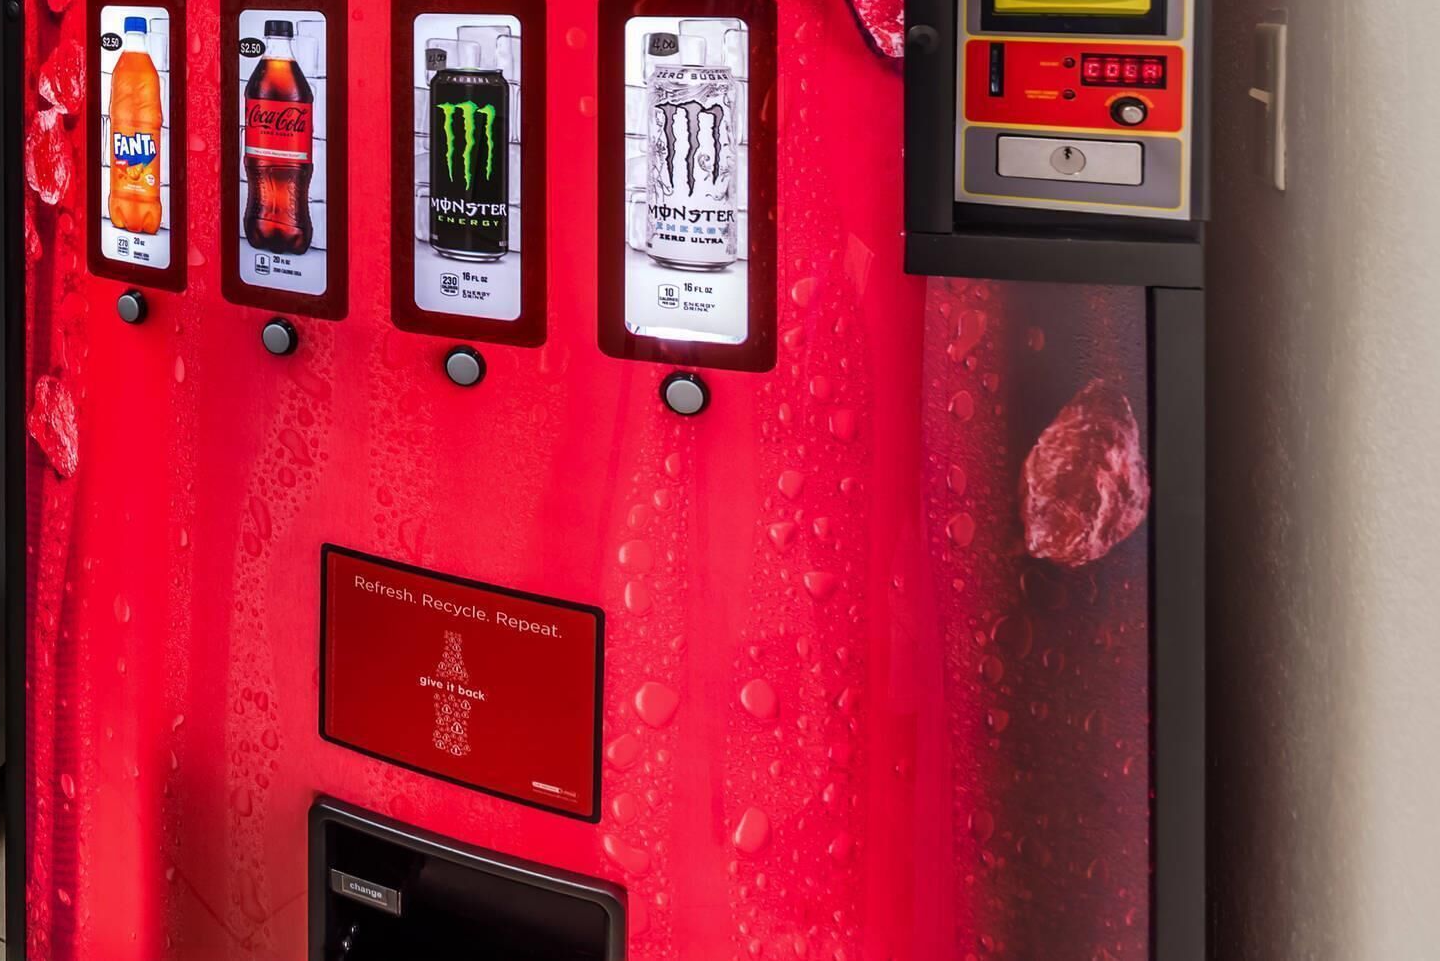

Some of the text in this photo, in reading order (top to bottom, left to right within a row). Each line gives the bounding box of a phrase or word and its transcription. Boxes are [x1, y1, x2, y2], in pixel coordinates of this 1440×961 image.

[103, 38, 119, 48] $2.50
[240, 43, 260, 53] $2.50
[653, 38, 675, 52] 4.00
[249, 104, 309, 132] Coca-Cola
[113, 133, 156, 156] FANTA
[431, 197, 507, 216] MONSTER
[648, 204, 735, 223] MONSTER
[438, 216, 500, 226] ENERGY
[656, 222, 729, 234] ENERGY
[119, 239, 128, 247] 270
[134, 237, 140, 245] 20
[659, 234, 686, 242] ZERO
[442, 276, 457, 286] 230
[462, 272, 470, 281] 16
[684, 283, 692, 291] 16
[665, 288, 674, 297] 10
[355, 576, 562, 639] Refresh. Recycle. Repeat.
[420, 676, 485, 700] give it back
[350, 880, 382, 899] change
